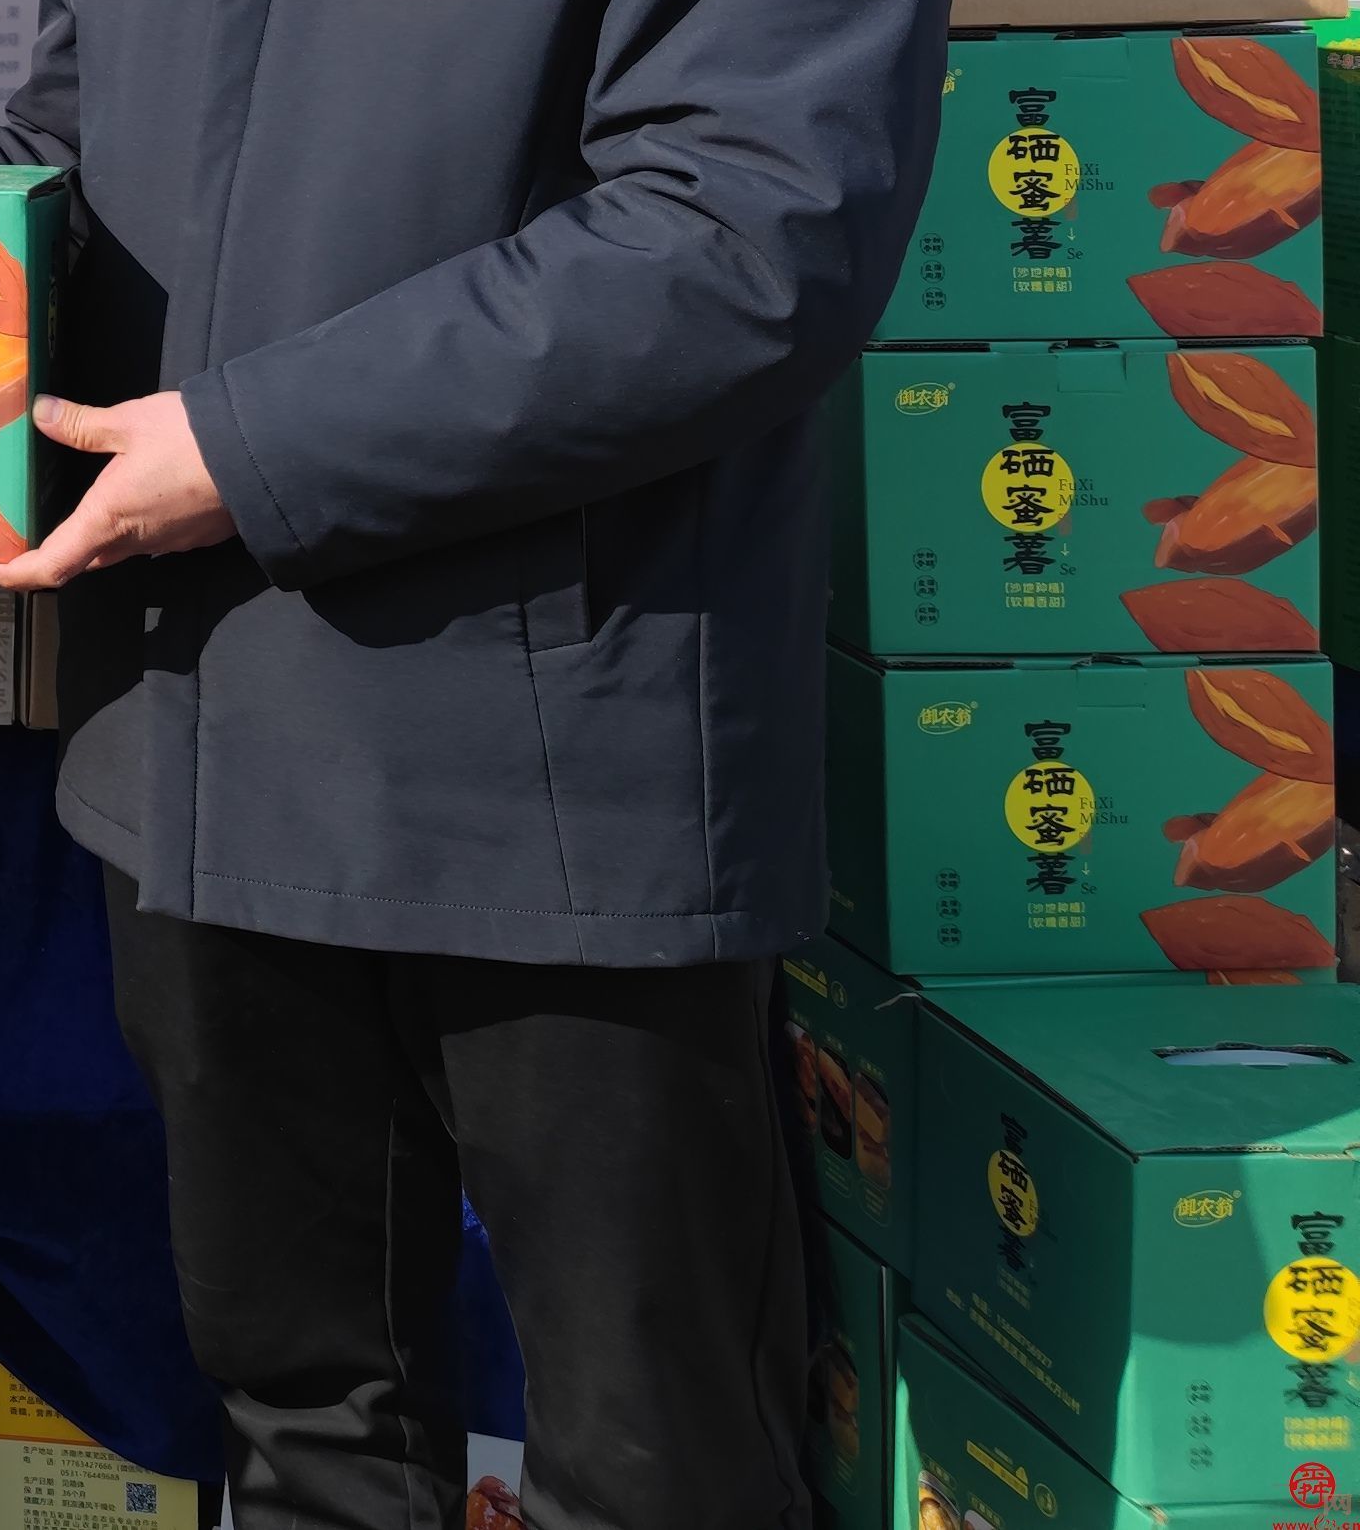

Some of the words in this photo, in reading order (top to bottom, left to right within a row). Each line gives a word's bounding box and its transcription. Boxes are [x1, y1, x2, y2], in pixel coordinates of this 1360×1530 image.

[1006, 86, 1063, 259] 富硒蜜薯
[1064, 163, 1100, 176] FuXi
[1064, 179, 1114, 191] MiShu
[1067, 248, 1084, 260] Se
[999, 401, 1056, 575] 富硒蜜薯
[1058, 478, 1094, 491] FuXi
[1058, 493, 1109, 506] MiShu
[1059, 563, 1077, 576] Se
[1023, 720, 1078, 895] 富硒蜜薯
[1079, 796, 1114, 810] FuXi
[1079, 812, 1129, 825] MiShu
[1081, 882, 1098, 895] Se
